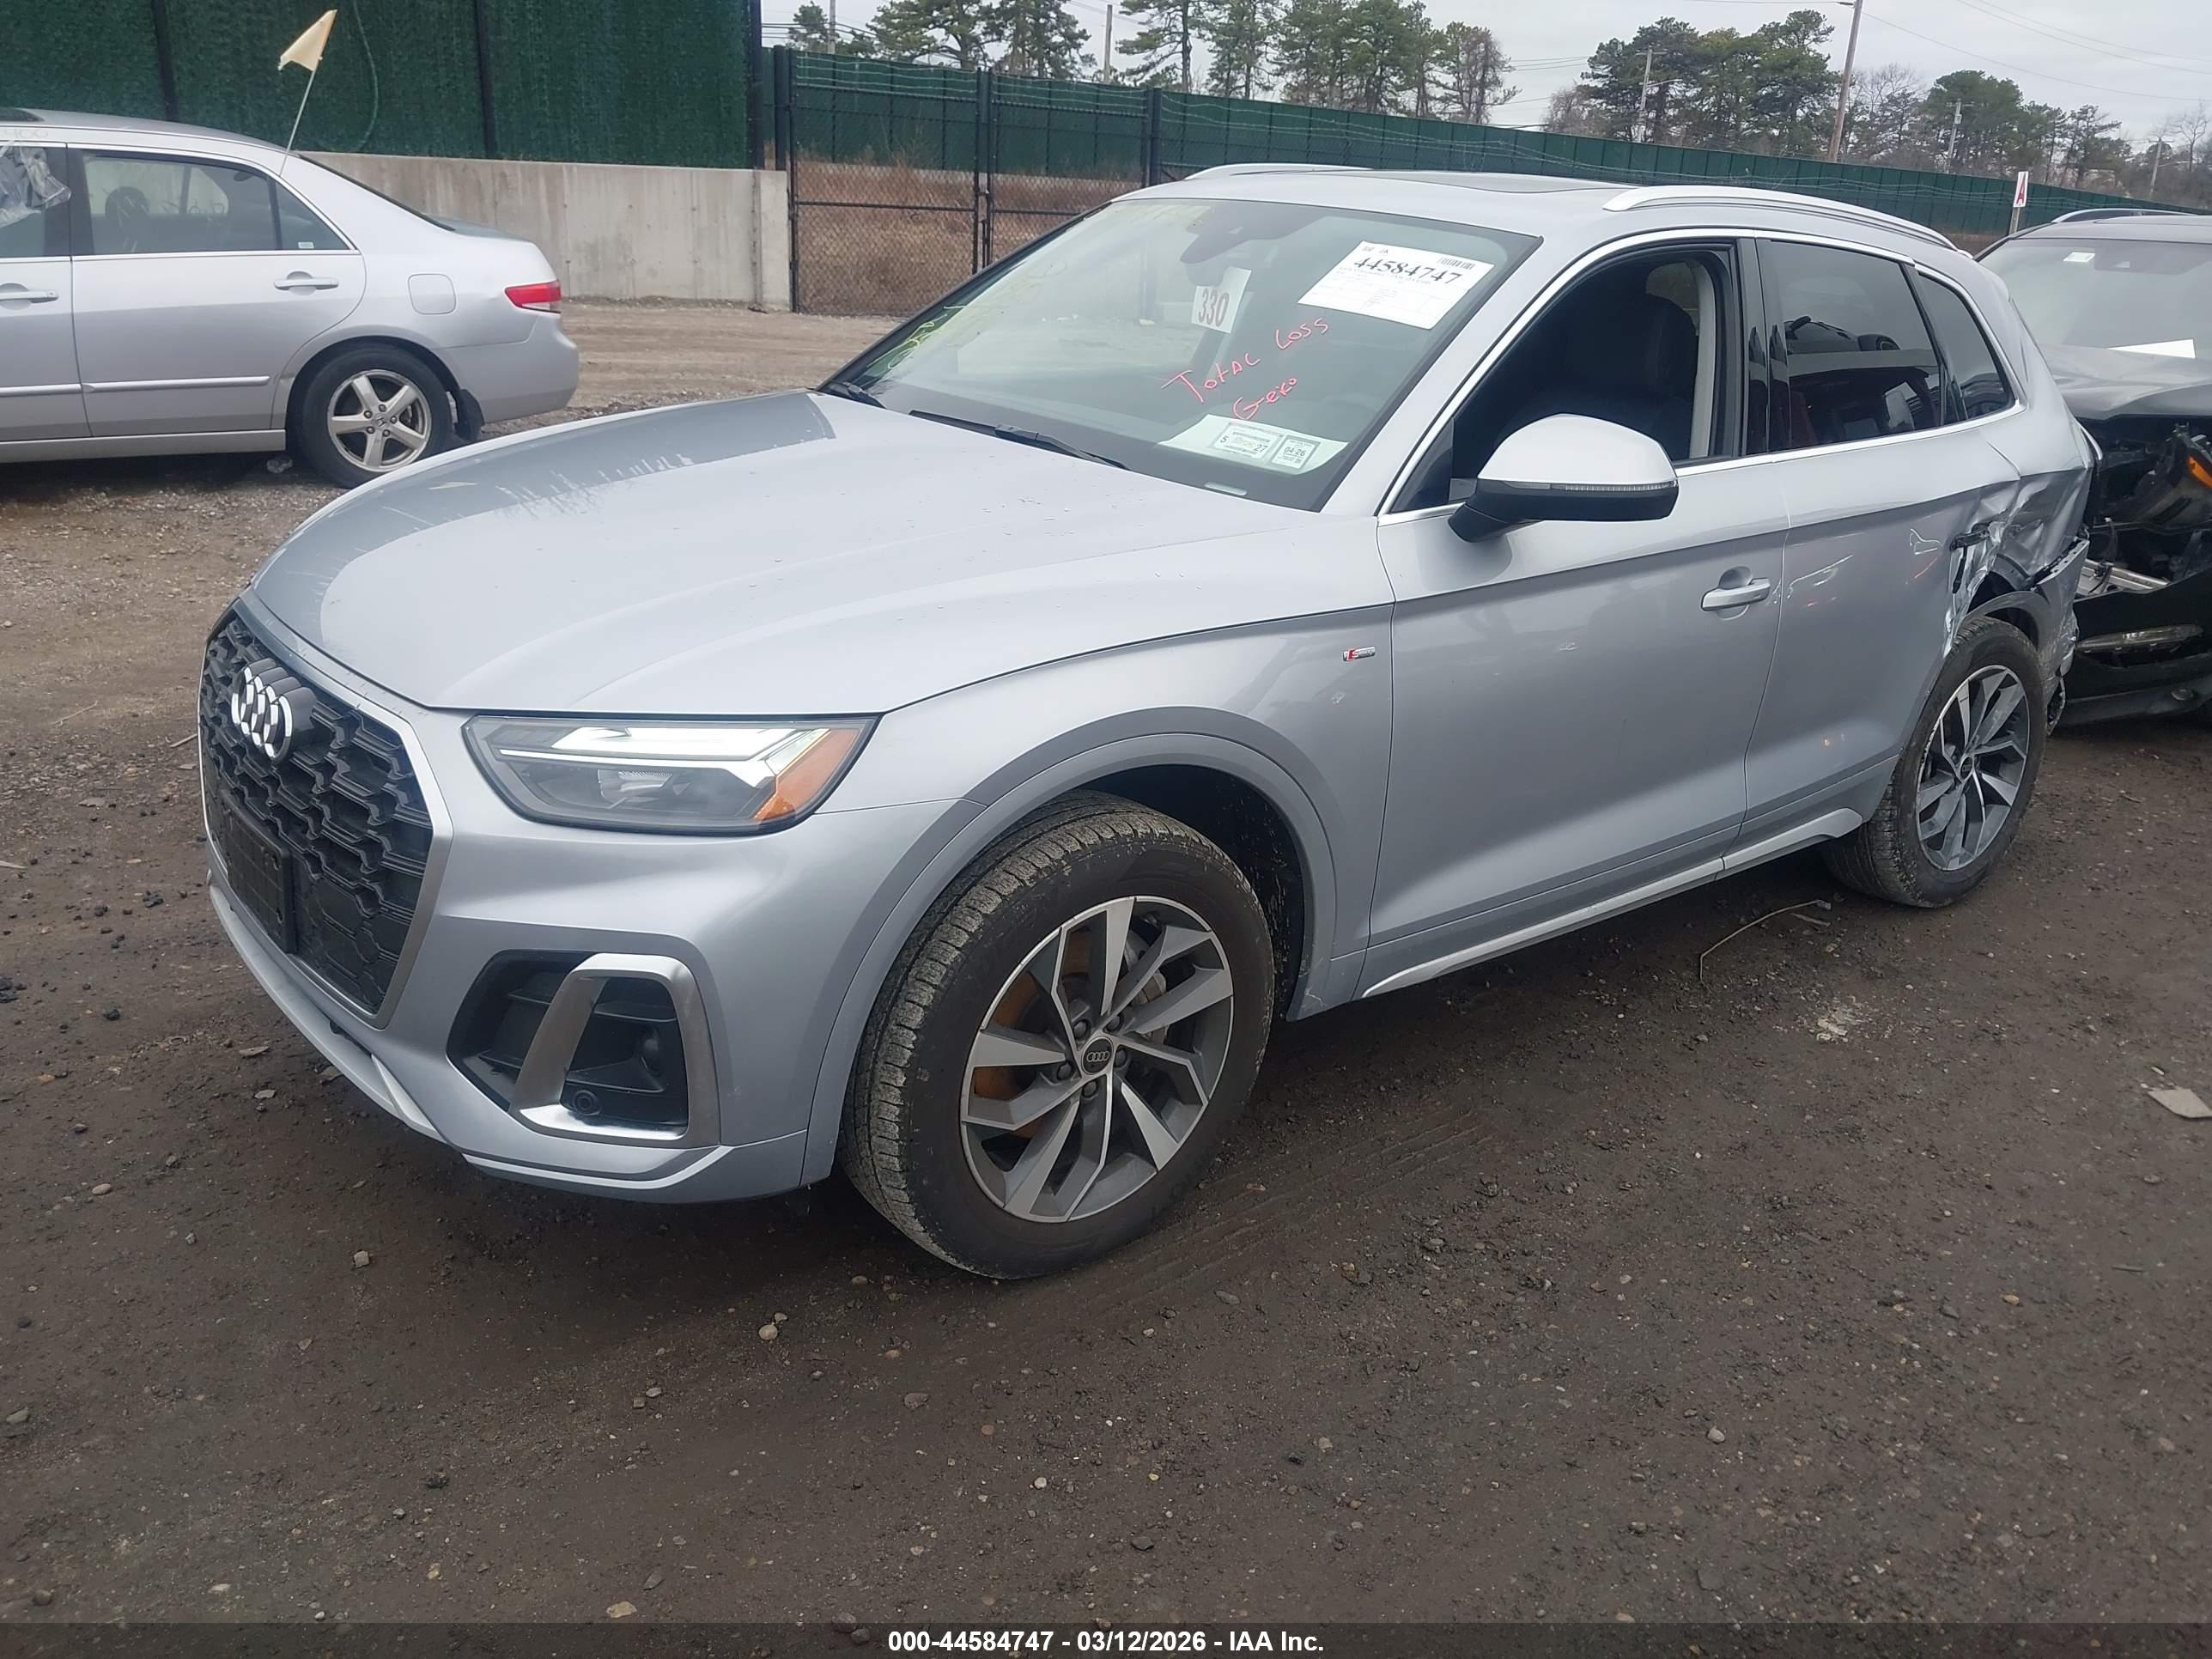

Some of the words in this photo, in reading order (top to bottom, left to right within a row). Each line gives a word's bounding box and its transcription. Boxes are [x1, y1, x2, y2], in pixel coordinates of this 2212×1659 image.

[1354, 258, 1462, 284] 44584747
[1199, 288, 1230, 327] 330
[1254, 444, 1268, 453] 27
